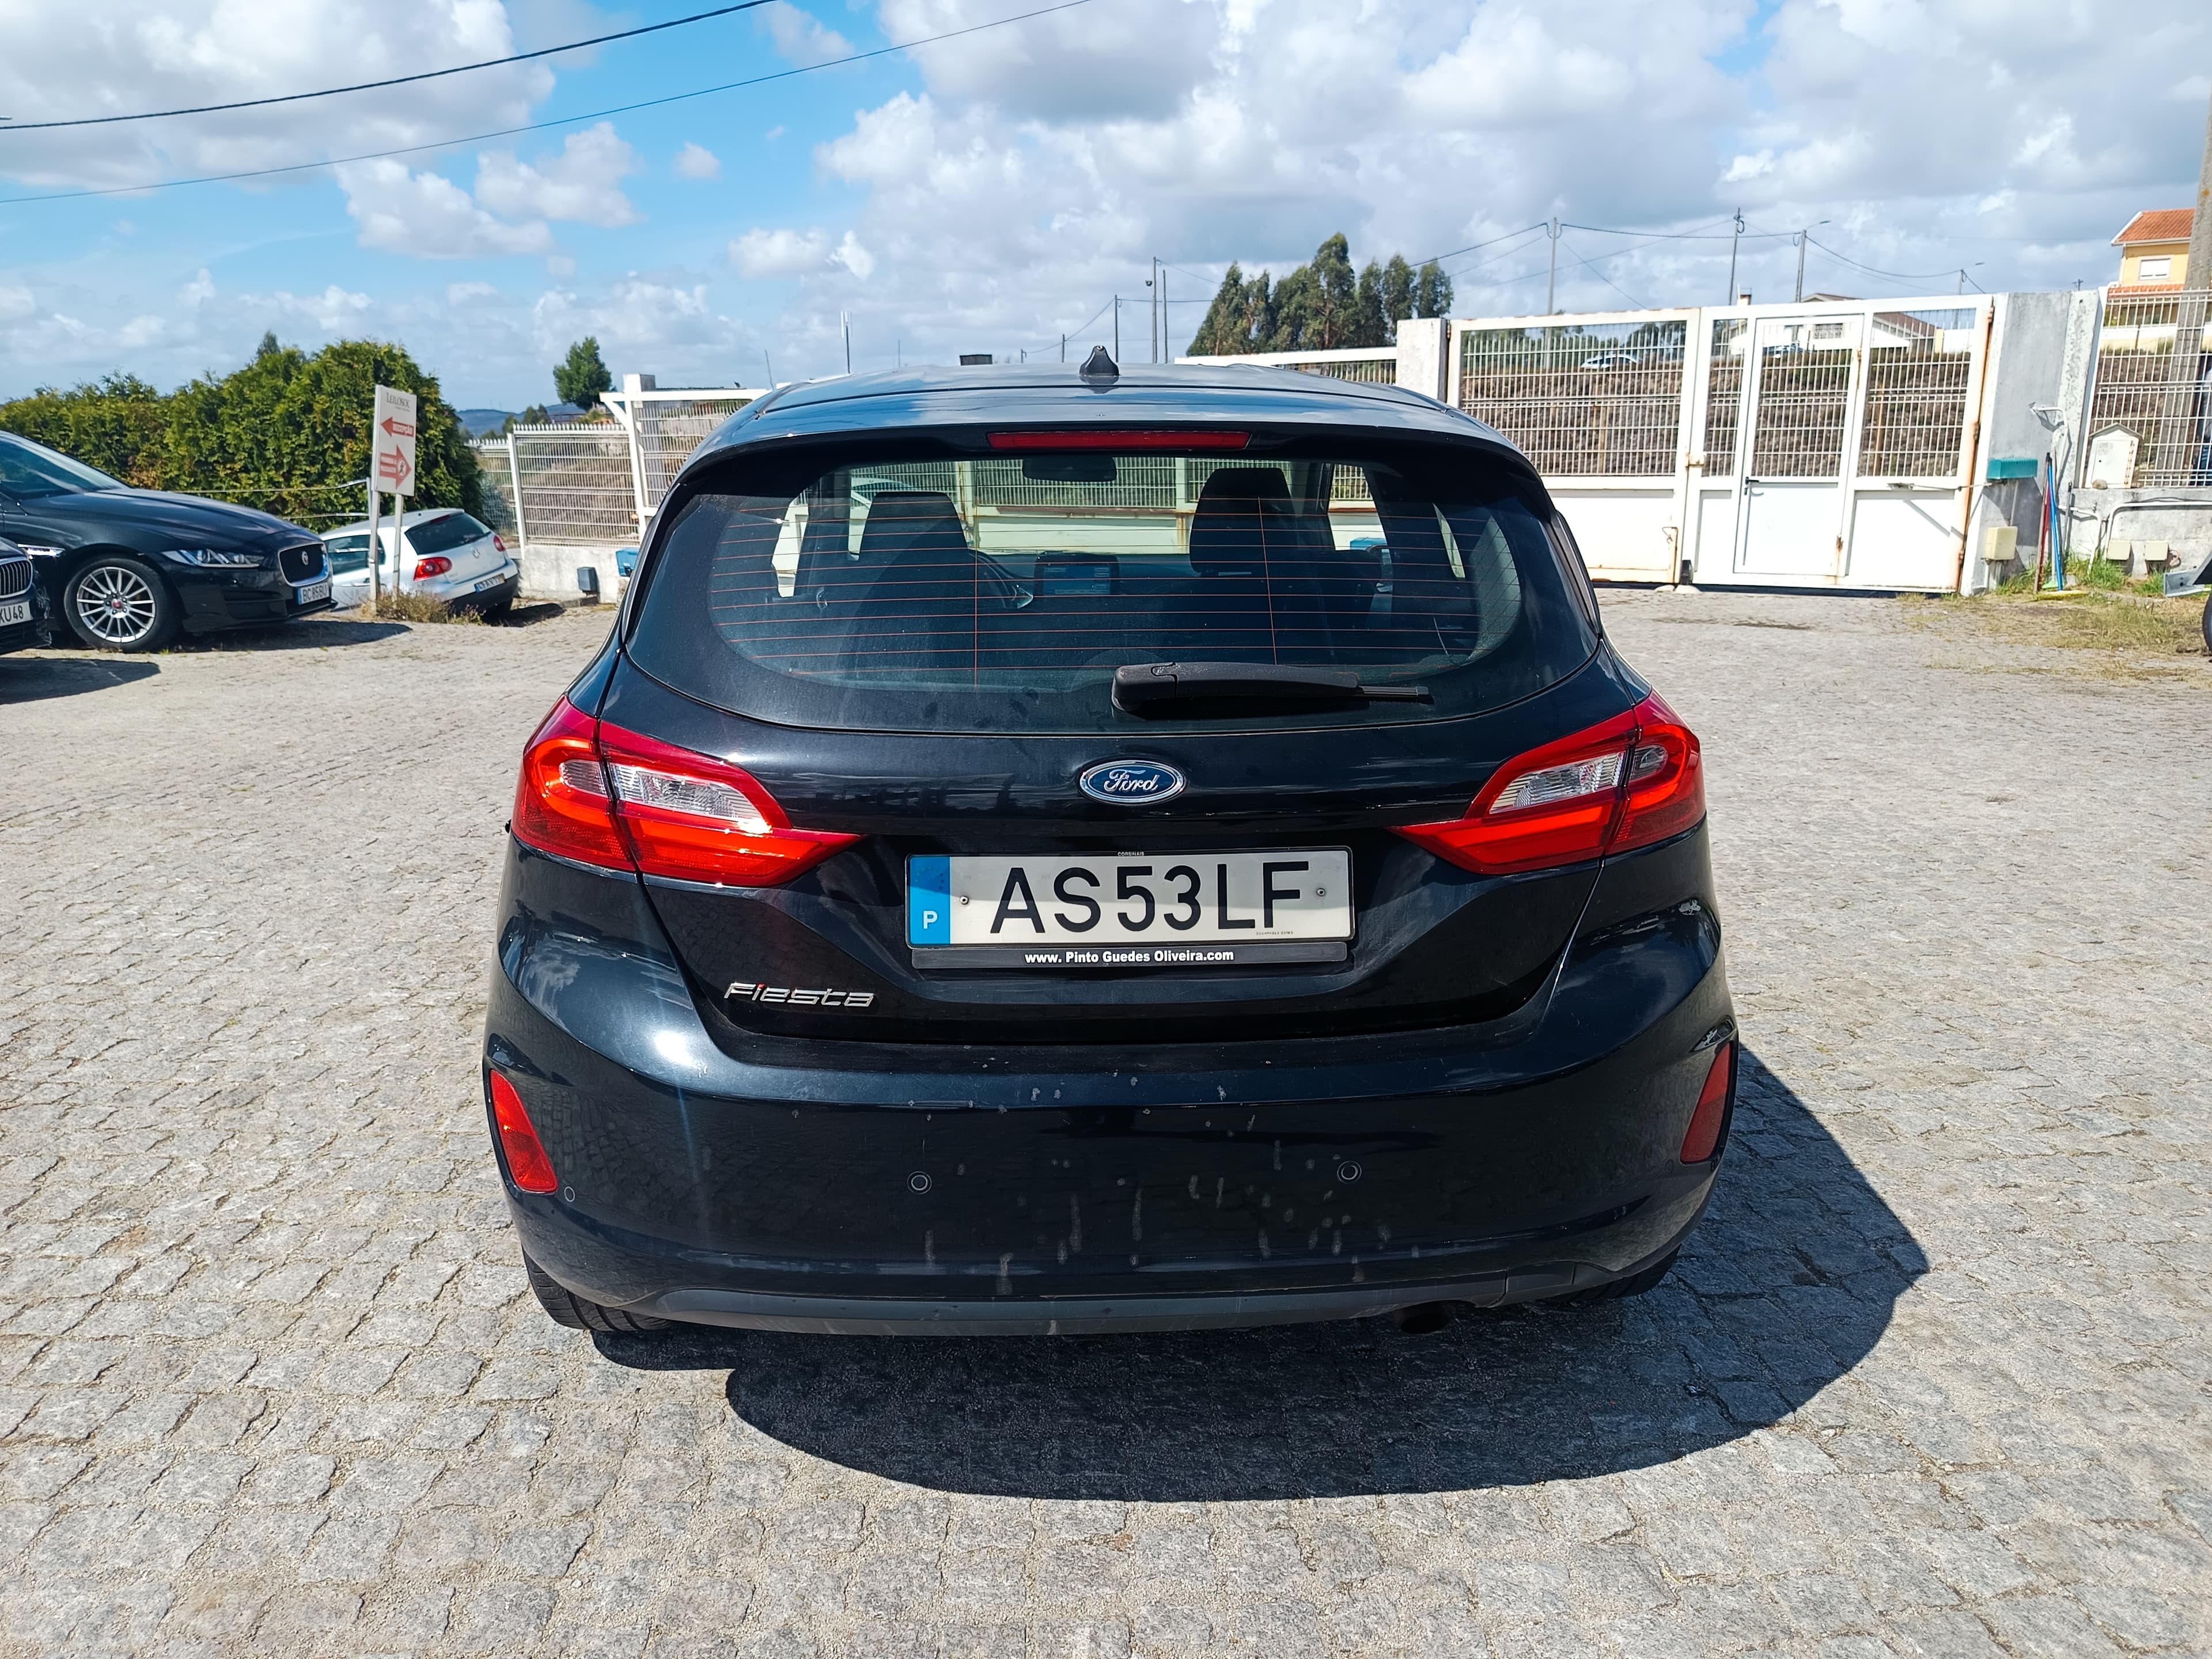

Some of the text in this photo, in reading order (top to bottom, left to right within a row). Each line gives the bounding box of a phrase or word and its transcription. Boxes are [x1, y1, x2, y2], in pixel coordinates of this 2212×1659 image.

[1103, 768, 1160, 793] Ford
[989, 861, 1309, 934] AS53LF
[923, 910, 938, 929] P
[1024, 949, 1234, 963] www. Pinto Guedes Oliveira.com
[724, 982, 874, 1007] Fiesta
